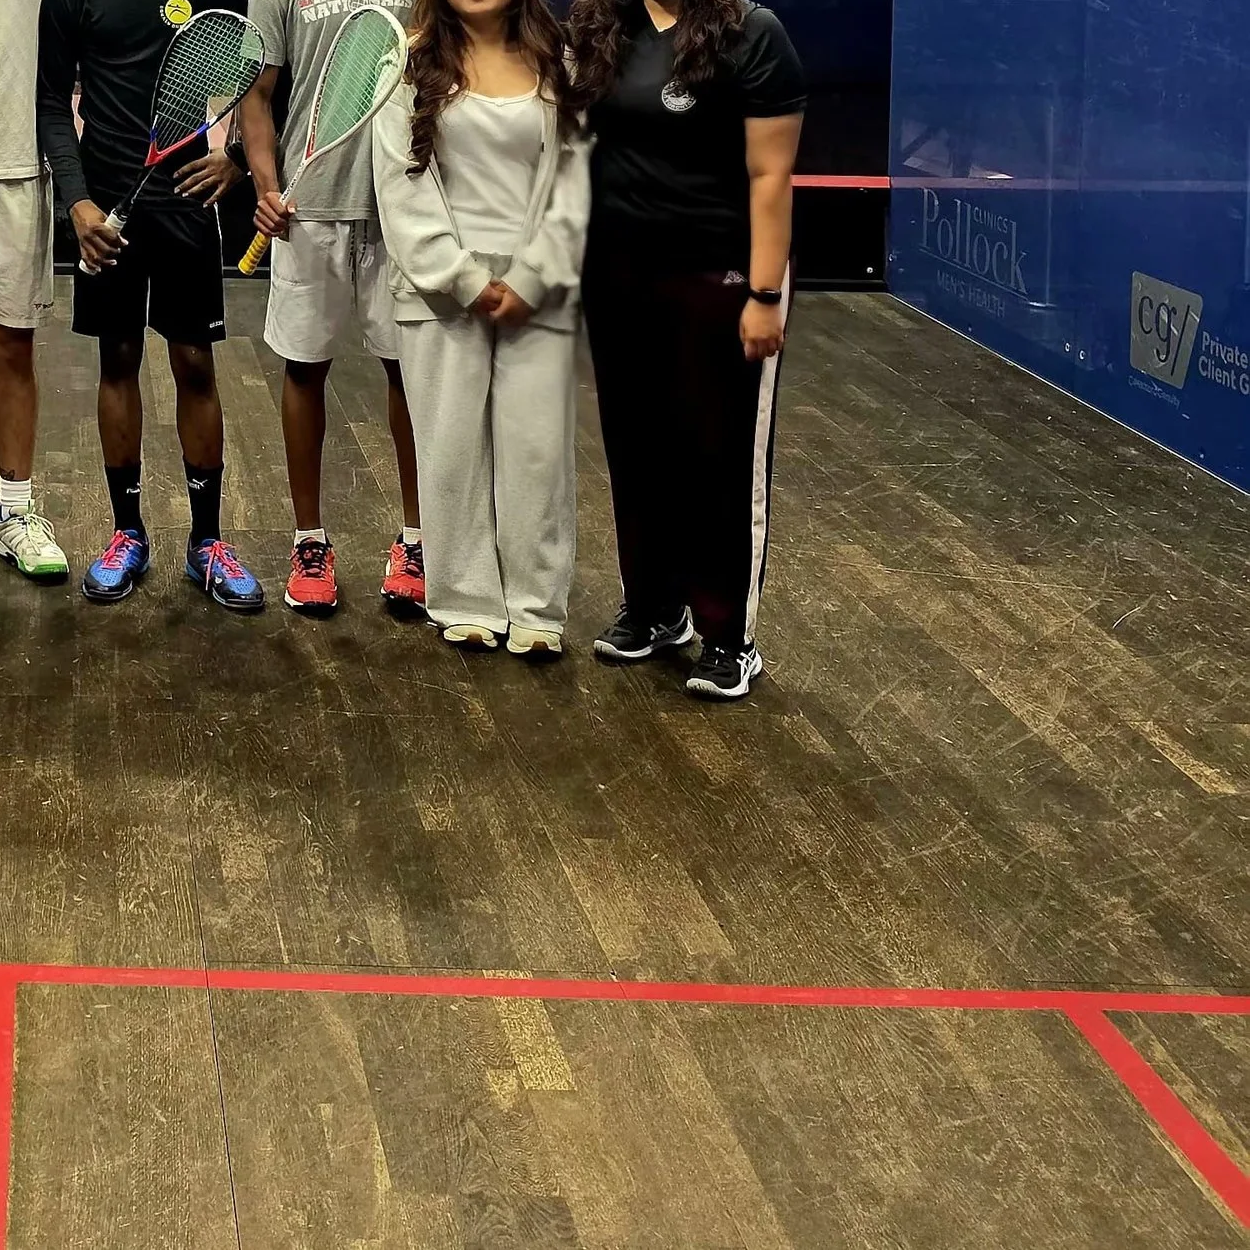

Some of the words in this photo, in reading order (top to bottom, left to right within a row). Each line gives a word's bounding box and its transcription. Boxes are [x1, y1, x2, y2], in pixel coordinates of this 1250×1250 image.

[973, 206, 1009, 234] CLINICS
[918, 187, 1029, 296] Pollock
[968, 288, 1006, 318] HEALTH
[1201, 330, 1249, 370] Private
[1198, 355, 1237, 391] Client
